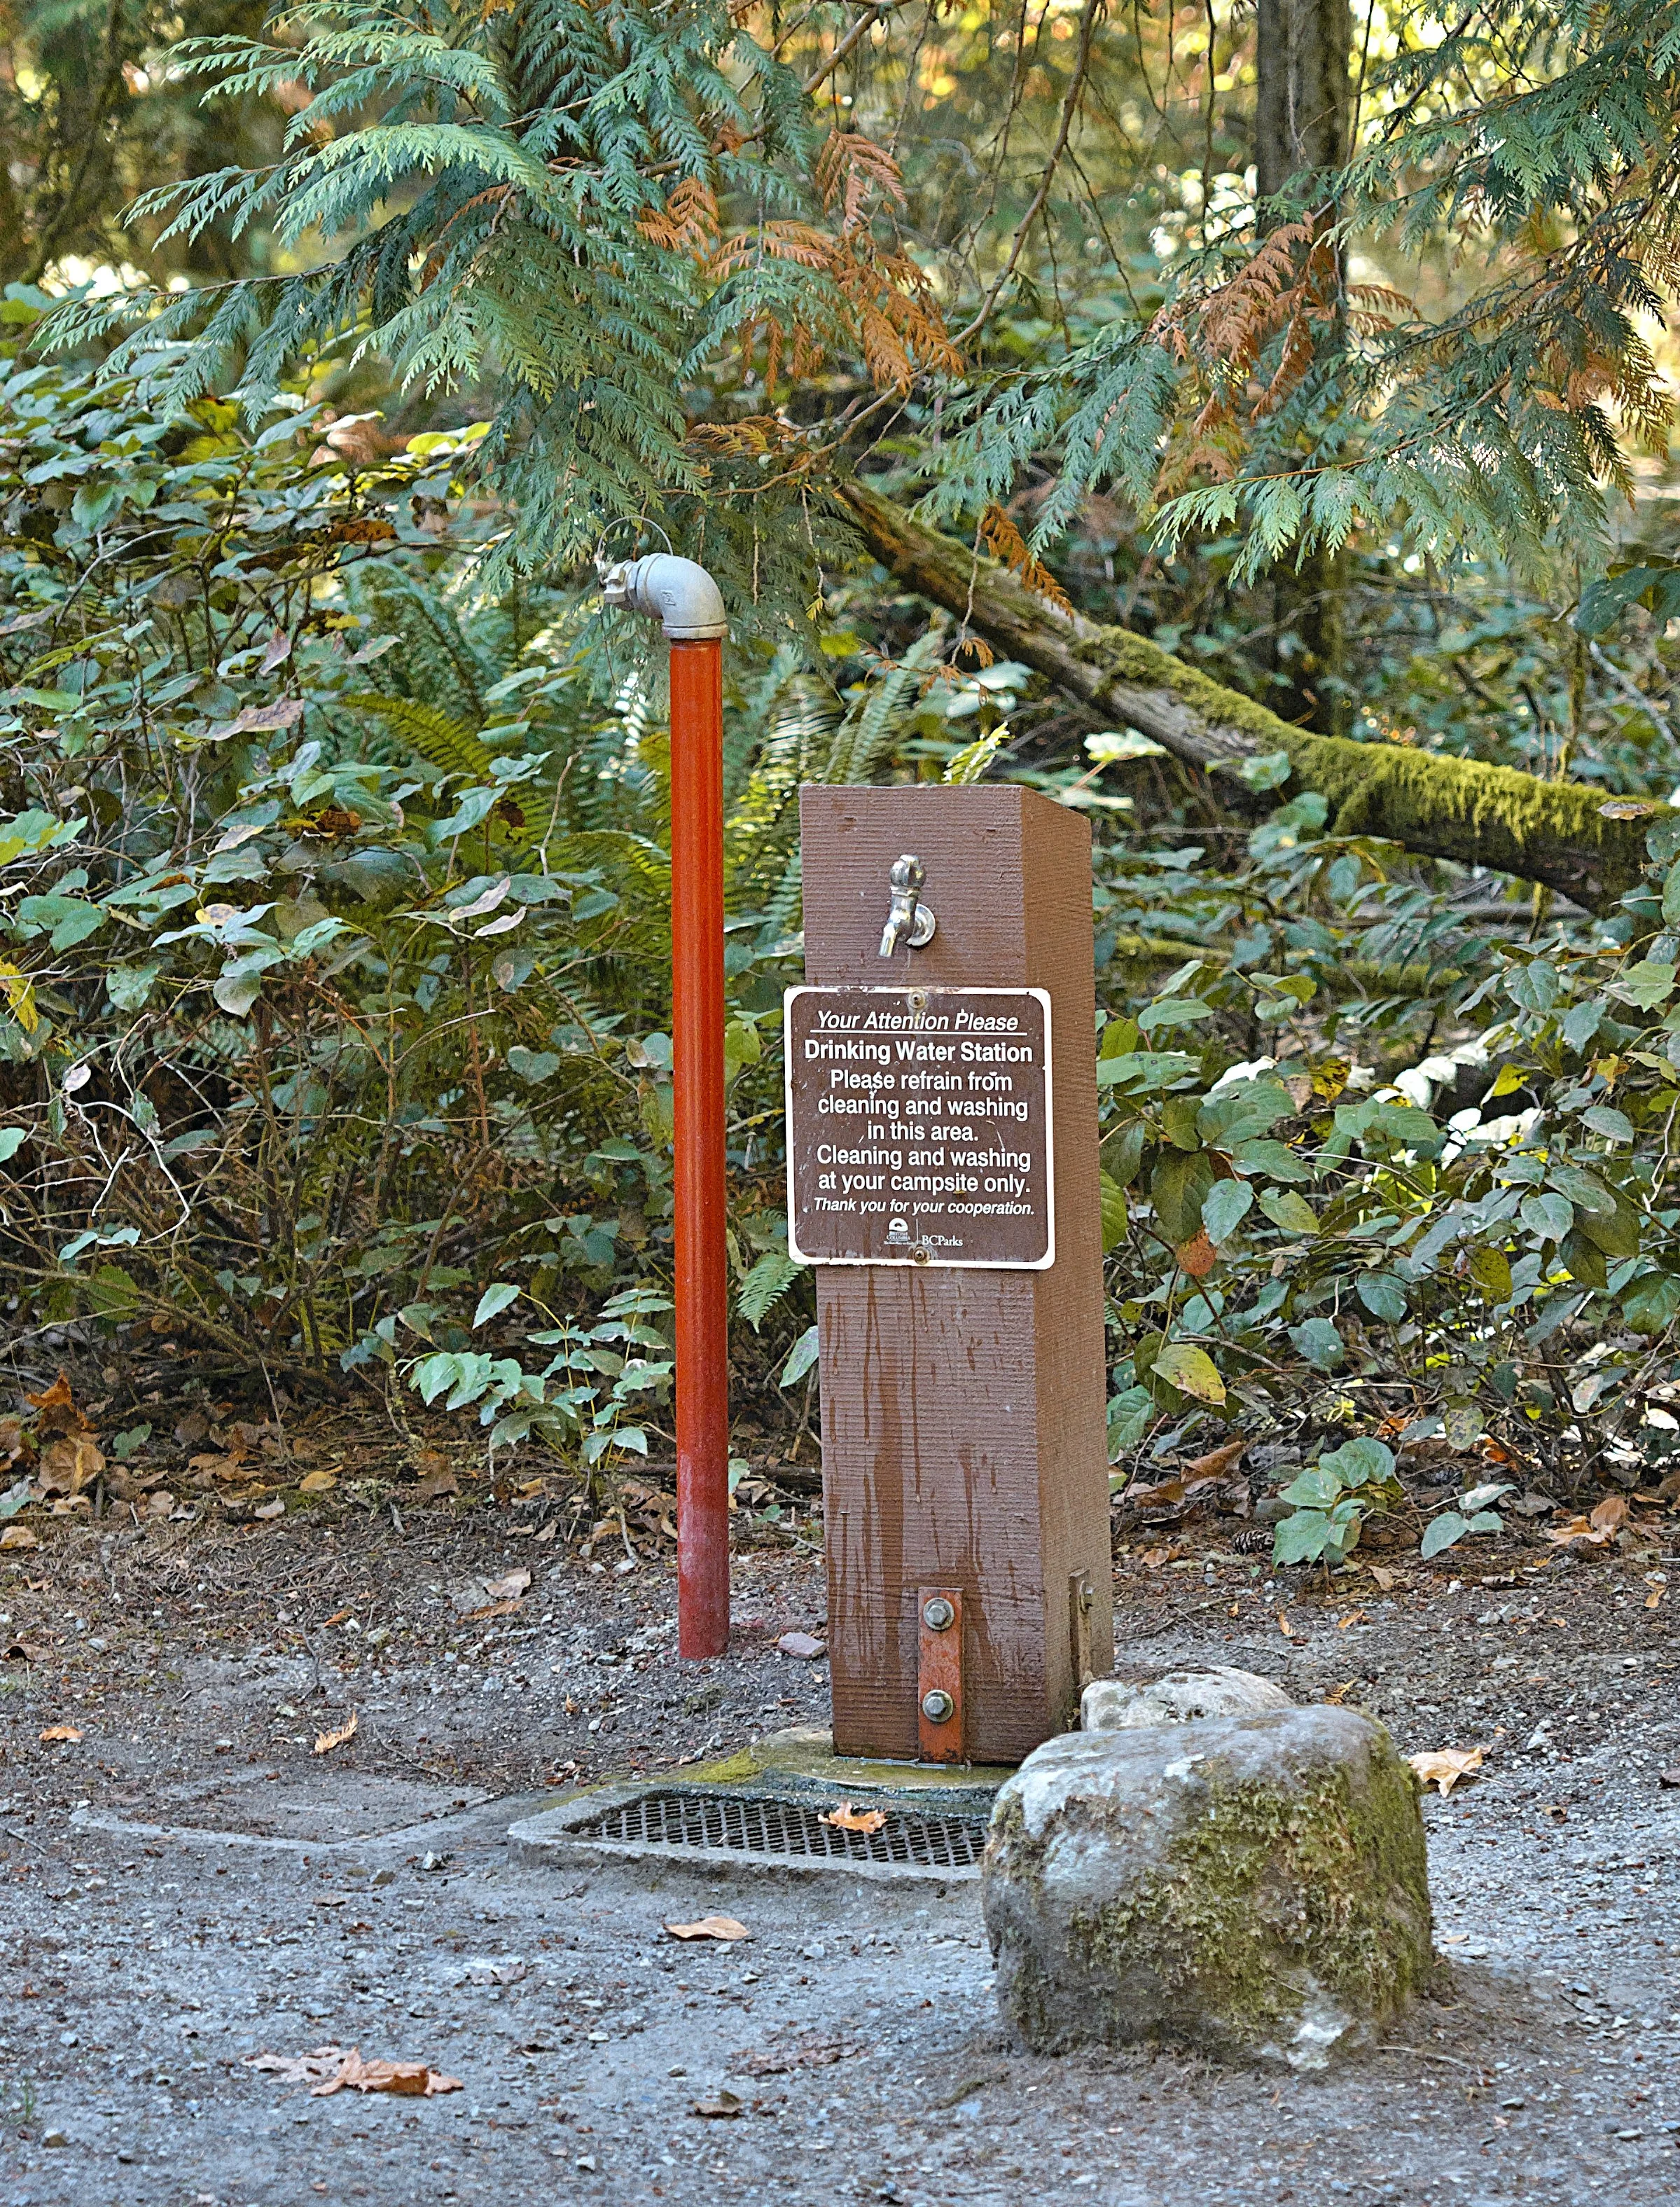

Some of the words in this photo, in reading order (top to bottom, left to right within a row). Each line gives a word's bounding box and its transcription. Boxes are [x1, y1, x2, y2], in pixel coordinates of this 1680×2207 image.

[817, 1010, 859, 1030] Your
[863, 1011, 949, 1030] Attention
[954, 1011, 1019, 1032] Please
[805, 1040, 891, 1065] Drinking
[895, 1041, 956, 1062] Water
[960, 1042, 1033, 1063] Station
[831, 1070, 895, 1090] Please
[901, 1072, 962, 1091] refrain
[968, 1072, 1012, 1091] from
[818, 1095, 899, 1119] cleaning
[905, 1098, 942, 1116] and
[947, 1098, 1028, 1122] washing
[868, 1121, 884, 1140] in
[890, 1121, 925, 1140] this
[931, 1126, 978, 1142] area.
[817, 1144, 902, 1170] Cleaning
[908, 1147, 945, 1166] and
[950, 1148, 1032, 1172] washing
[819, 1172, 836, 1189] at
[842, 1175, 885, 1194] your
[891, 1174, 978, 1196] campsite
[984, 1175, 1031, 1197] only.
[814, 1197, 856, 1212] Thank
[859, 1201, 887, 1215] you
[890, 1198, 910, 1213] for
[912, 1203, 945, 1215] your
[947, 1202, 1034, 1216] cooperation.
